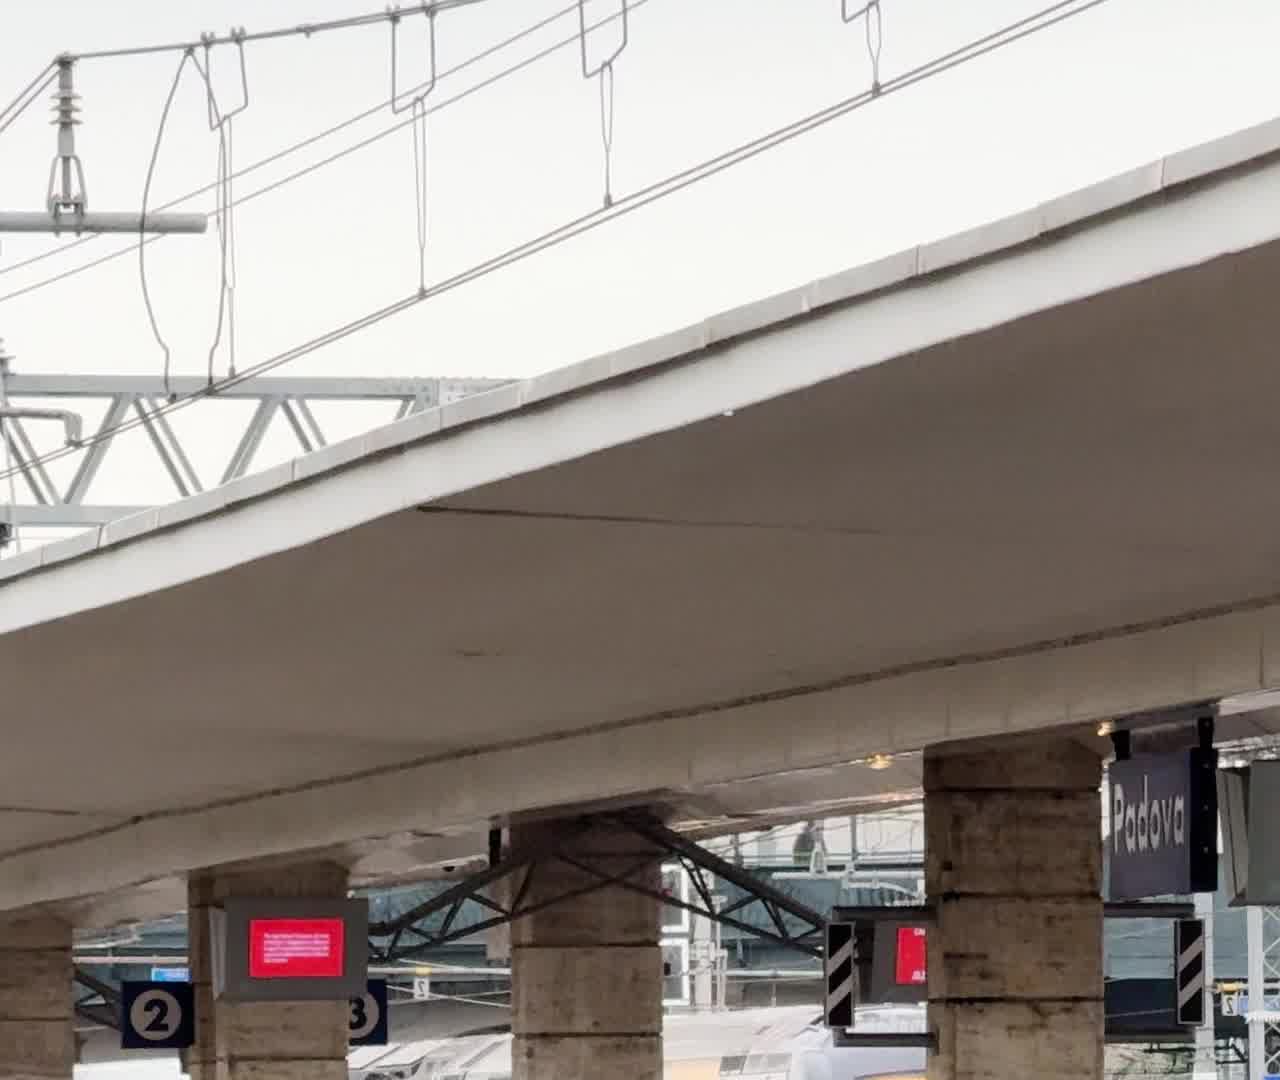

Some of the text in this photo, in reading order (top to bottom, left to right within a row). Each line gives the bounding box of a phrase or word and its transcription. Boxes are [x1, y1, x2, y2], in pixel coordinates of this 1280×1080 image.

[1113, 774, 1185, 855] Padova
[143, 998, 169, 1031] 2
[349, 998, 368, 1030] 3
